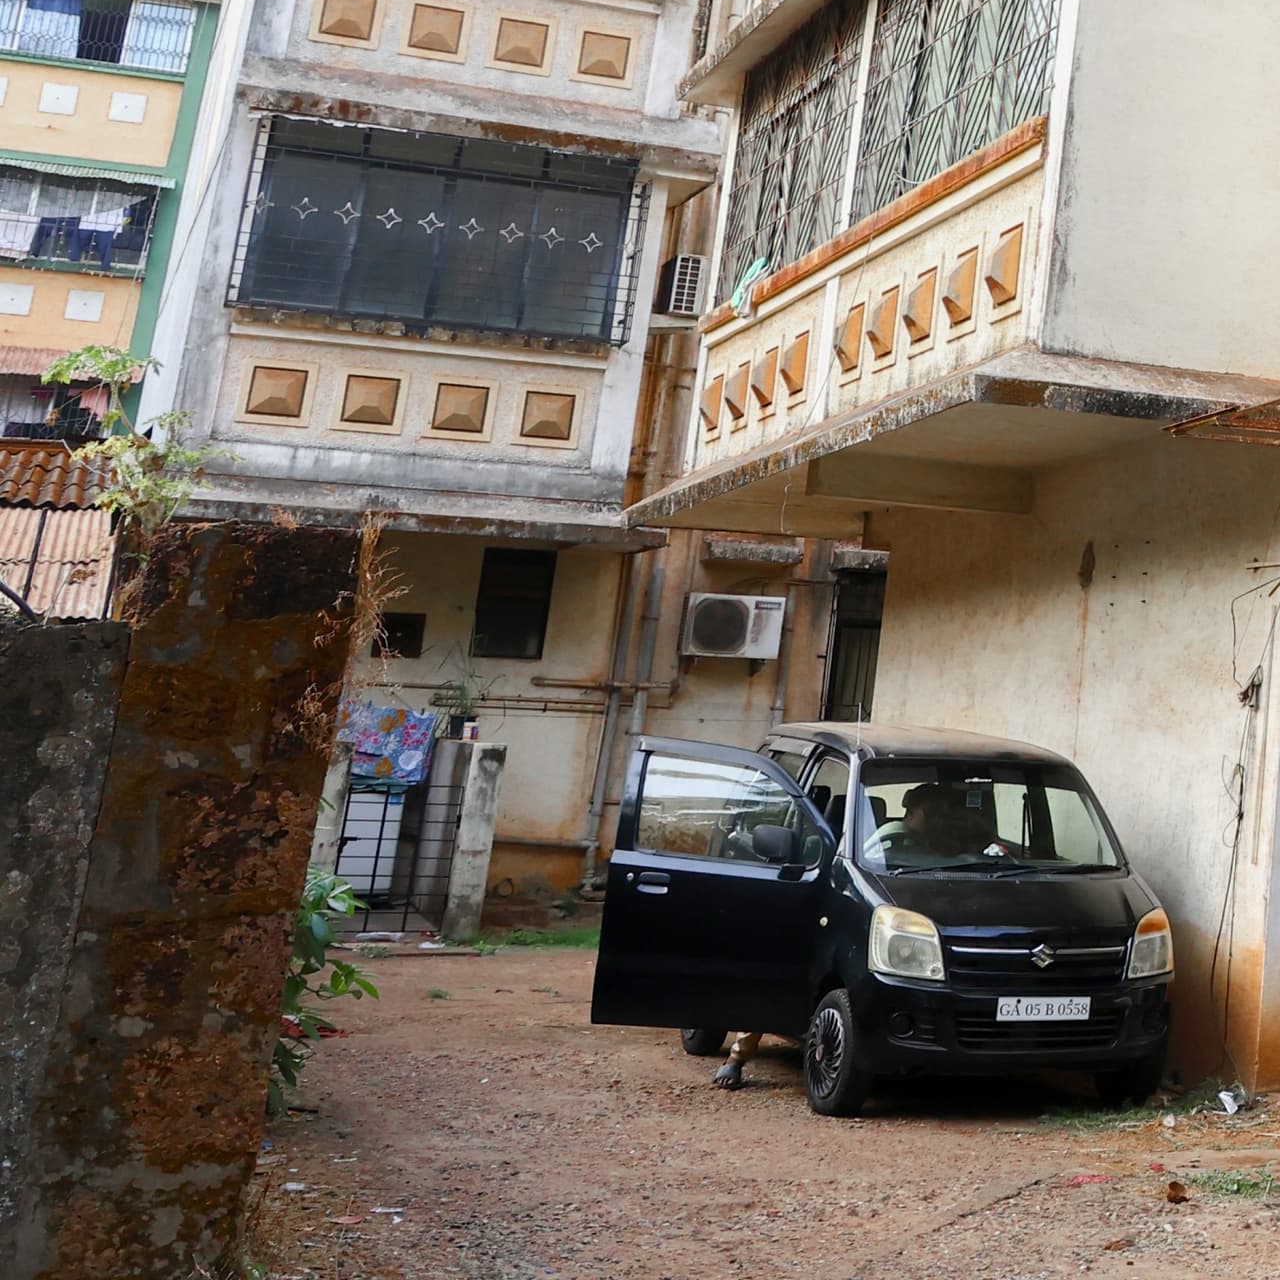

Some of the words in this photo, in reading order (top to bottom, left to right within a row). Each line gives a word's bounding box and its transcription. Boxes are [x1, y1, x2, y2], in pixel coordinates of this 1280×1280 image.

[1000, 1003, 1021, 1017] GA
[1025, 1003, 1041, 1017] 05
[1045, 1003, 1055, 1016] B
[1058, 1003, 1088, 1016] 0558
